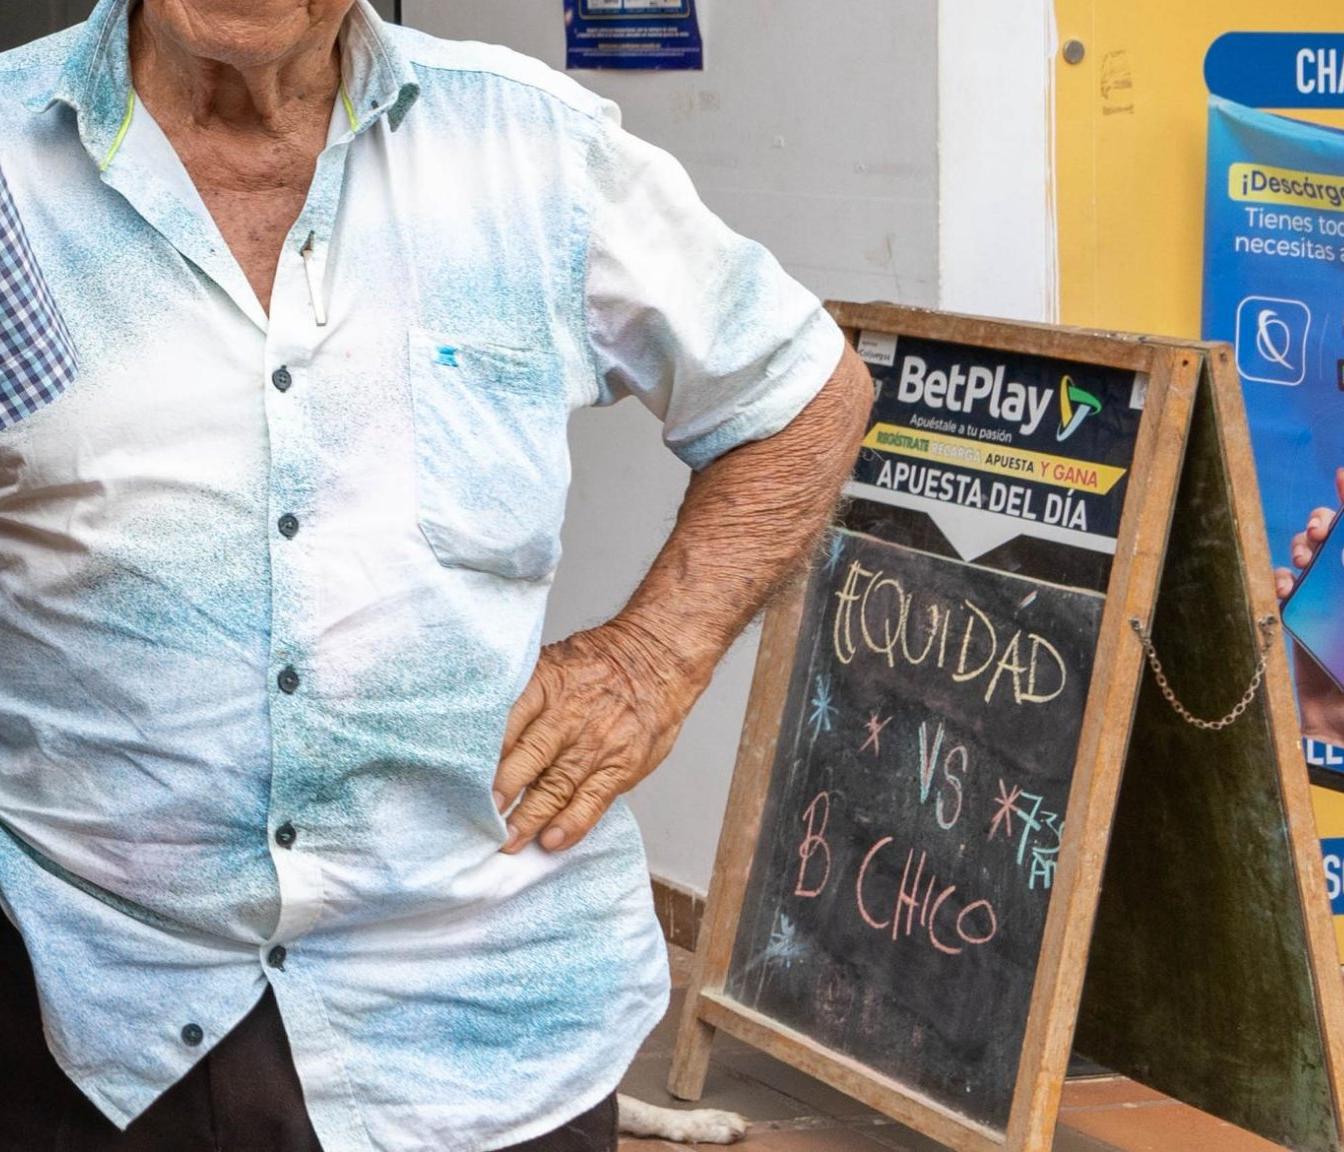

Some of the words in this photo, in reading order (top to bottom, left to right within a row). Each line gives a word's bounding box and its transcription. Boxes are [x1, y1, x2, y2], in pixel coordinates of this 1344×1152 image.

[1235, 235, 1335, 261] necesitas
[1244, 207, 1313, 233] Tienes
[897, 355, 1054, 436] BetPlay
[876, 430, 929, 452] REGÍSTRATE
[985, 453, 1035, 473] APUESTA
[1040, 461, 1051, 478] Y
[1053, 465, 1098, 488] GANA
[910, 413, 957, 434] Apuéstale
[958, 426, 966, 435] a
[967, 425, 978, 437] tu
[979, 425, 1012, 445] pasión
[875, 460, 982, 509] APUESTA
[988, 482, 1036, 521] DEL
[1043, 488, 1087, 531] DÍA
[918, 721, 969, 831] VS
[794, 790, 831, 897] B
[856, 836, 997, 954] CHICO
